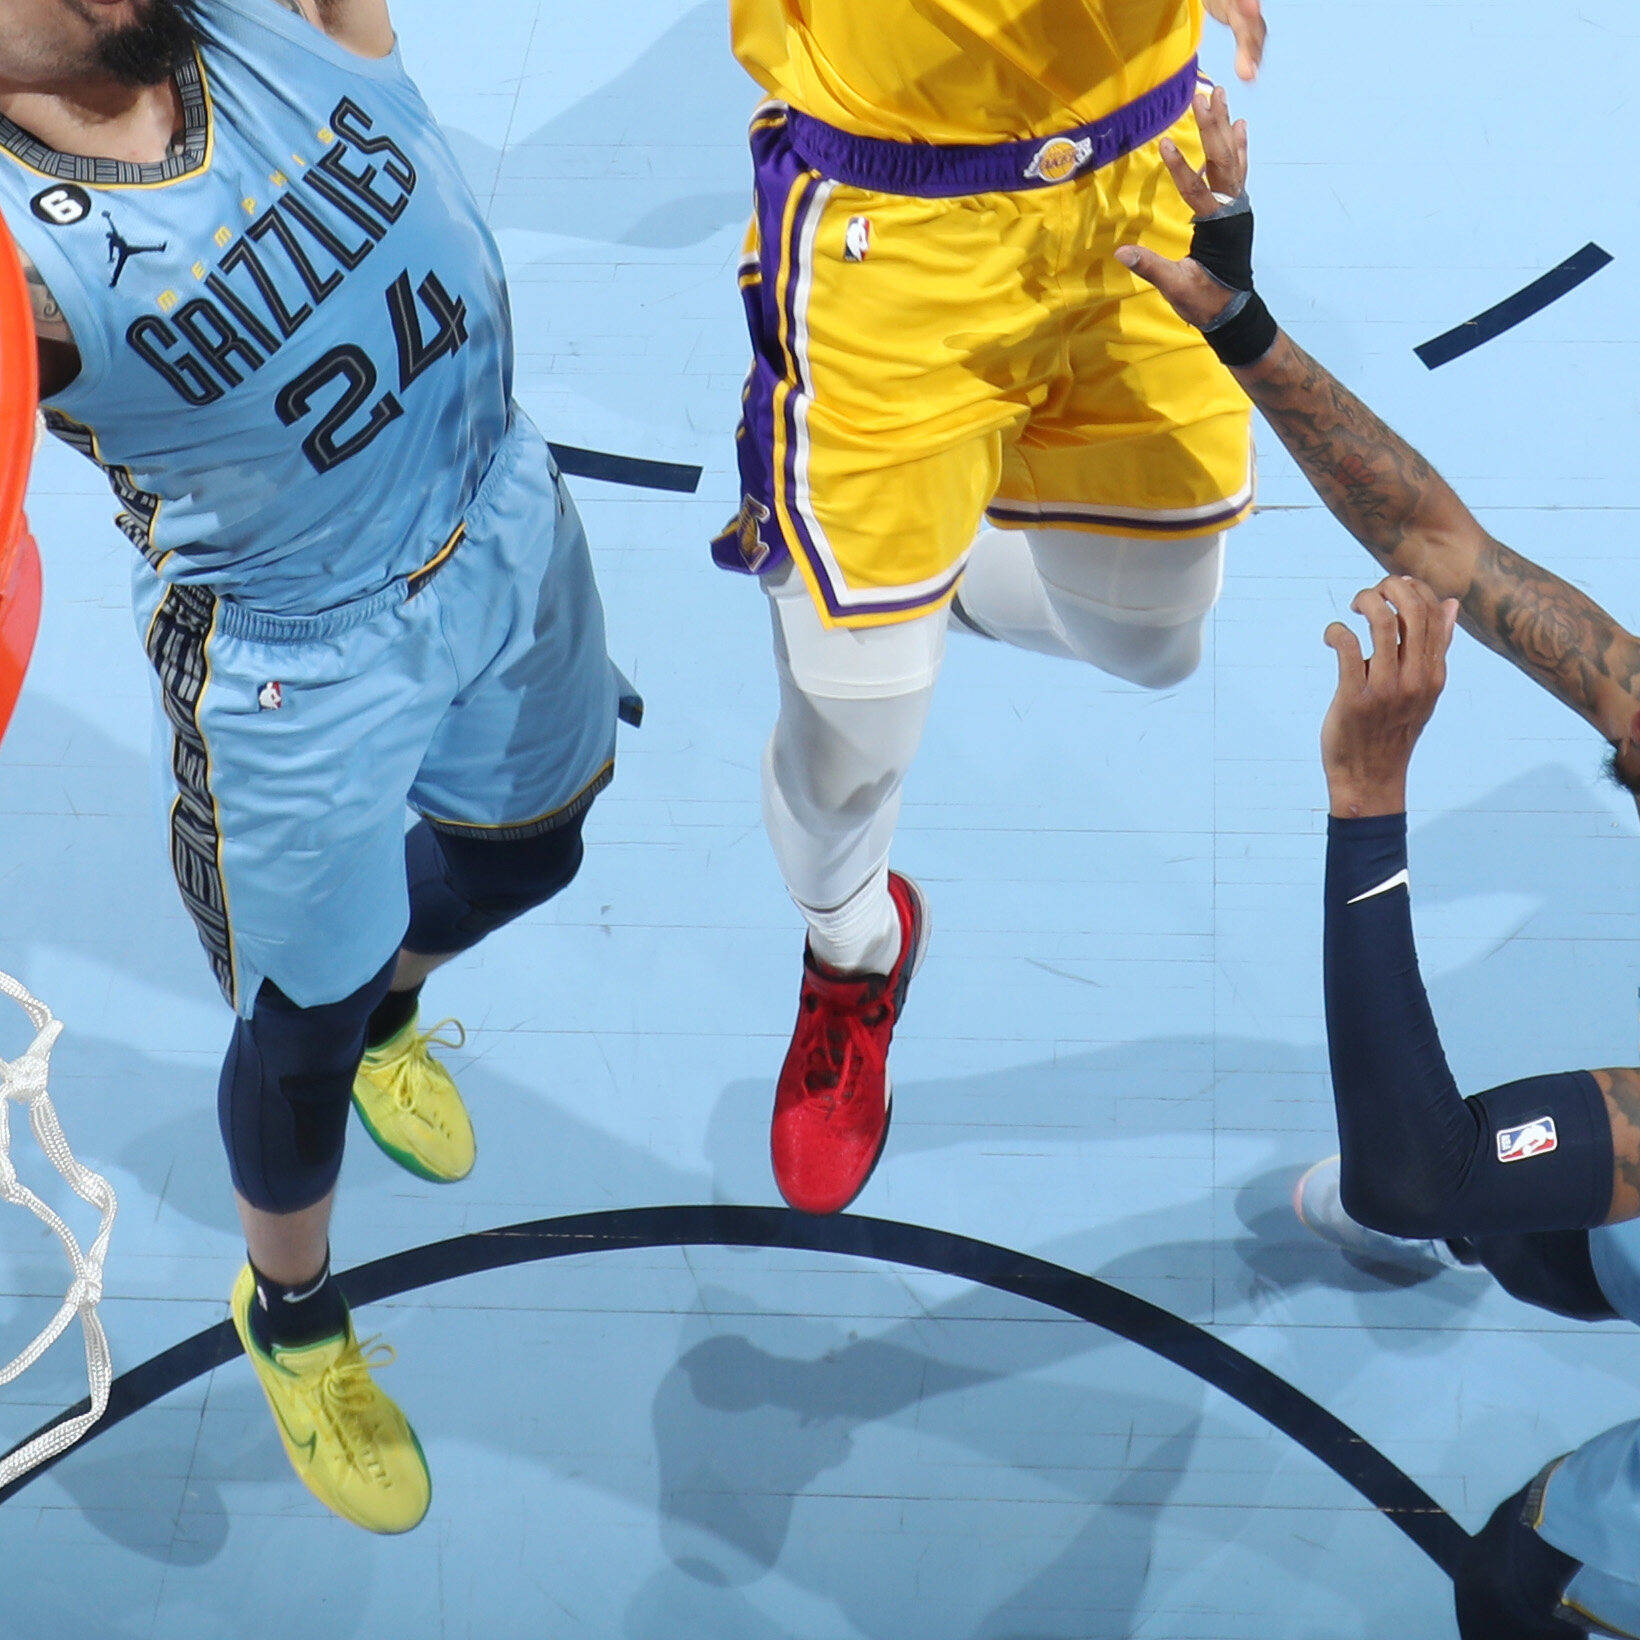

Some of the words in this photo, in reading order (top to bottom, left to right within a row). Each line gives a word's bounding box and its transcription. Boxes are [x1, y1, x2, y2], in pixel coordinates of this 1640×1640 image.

[39, 189, 84, 224] 6
[124, 93, 418, 408] GRIZZLIES
[273, 266, 470, 476] 24
